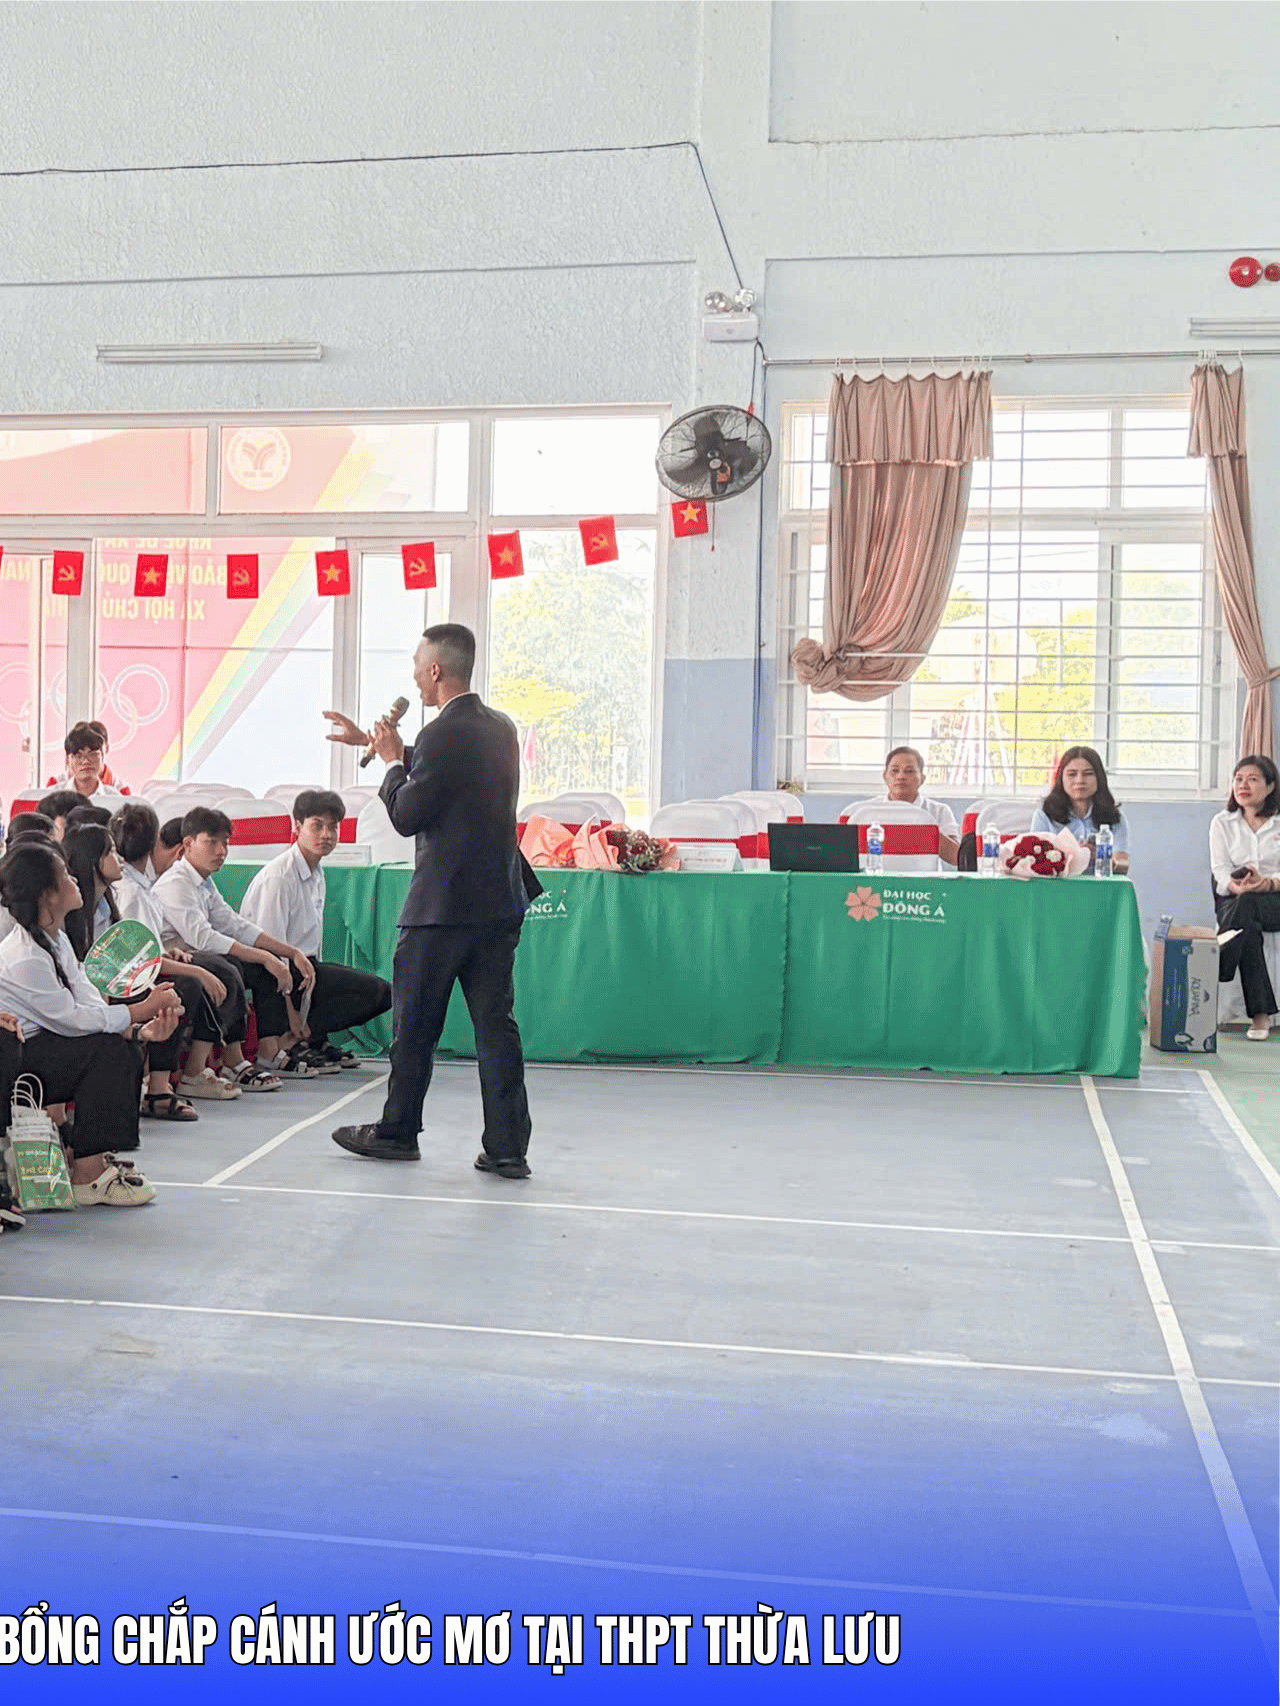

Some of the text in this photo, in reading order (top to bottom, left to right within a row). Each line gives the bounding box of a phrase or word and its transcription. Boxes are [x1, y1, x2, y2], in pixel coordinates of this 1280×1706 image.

[883, 889, 932, 902] ĐẠI HỌC
[882, 901, 931, 916] ĐÔNG
